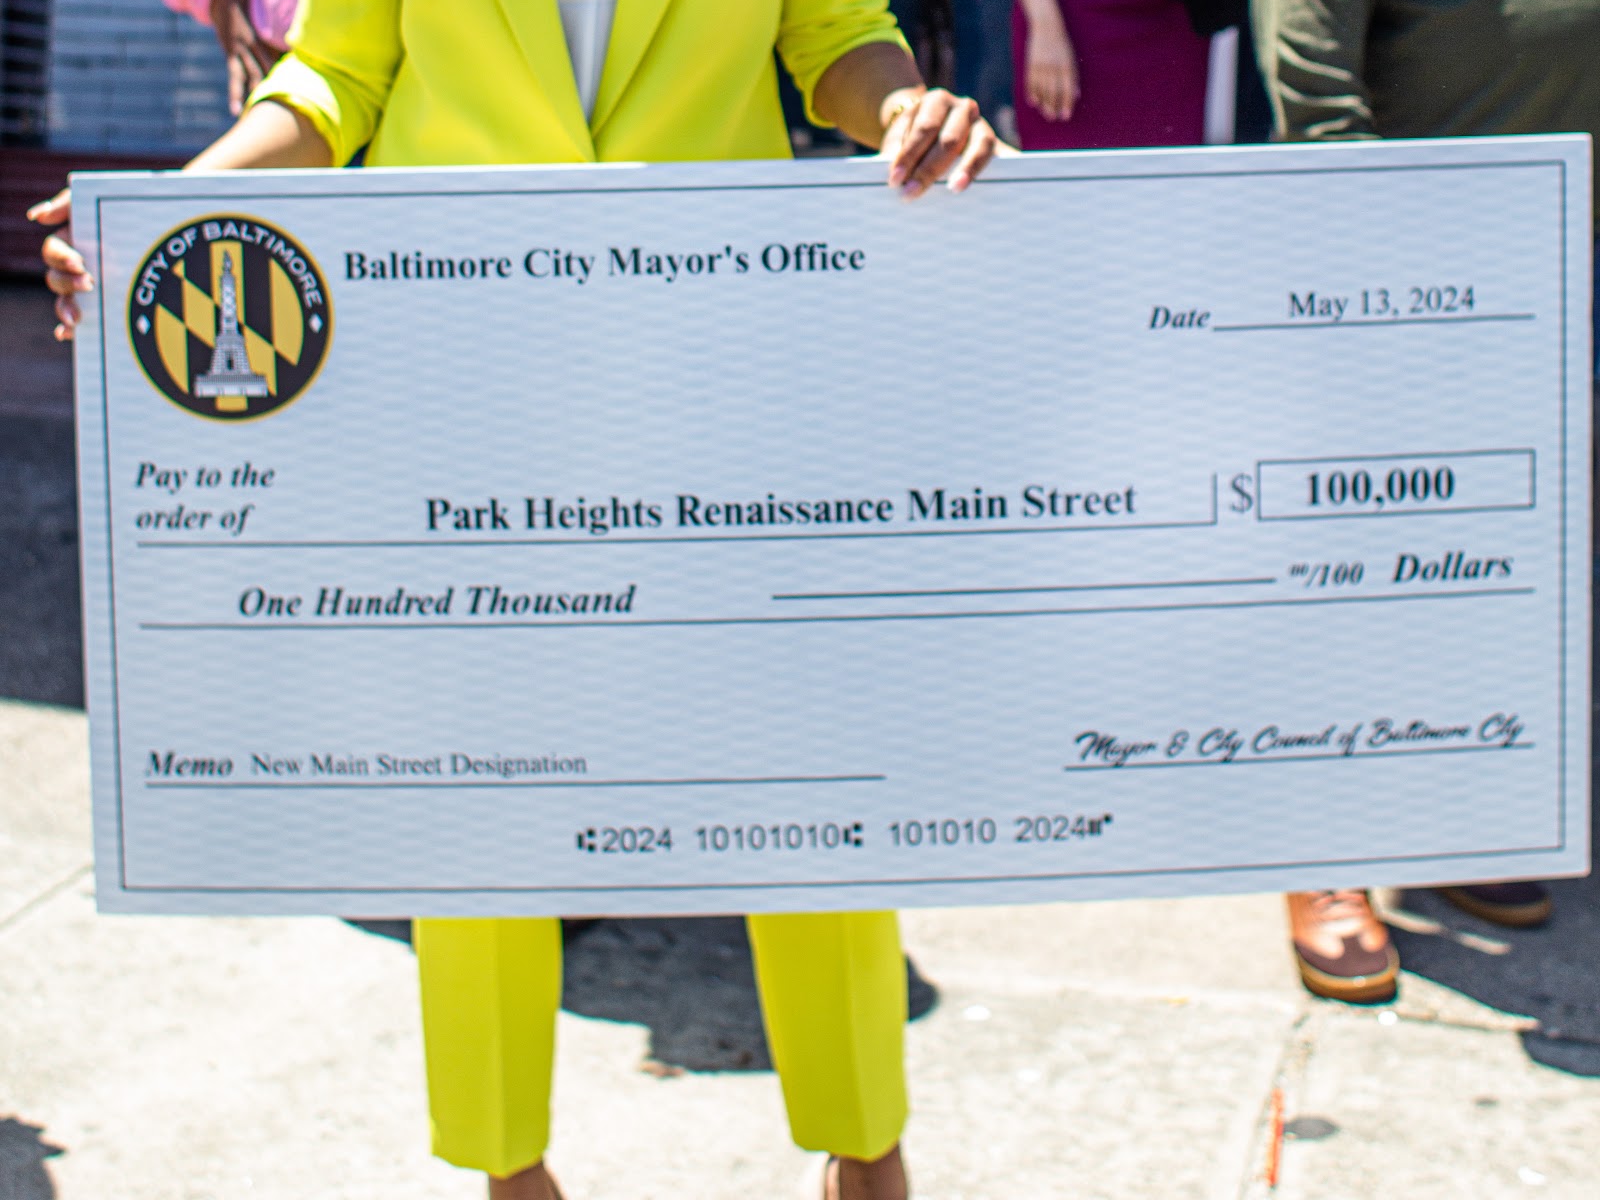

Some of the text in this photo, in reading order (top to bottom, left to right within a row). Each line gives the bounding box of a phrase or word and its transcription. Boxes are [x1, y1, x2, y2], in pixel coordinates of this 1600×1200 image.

[135, 220, 324, 309] CITY OF BALTIMORE
[344, 242, 866, 284] Baltimore City Mayor's Office
[1149, 286, 1475, 330] Date May 13, 2024
[135, 462, 275, 494] Pay to the
[1229, 466, 1455, 513] $ 100,000
[135, 504, 255, 536] order of
[426, 485, 1135, 535] Park Heights Renaissance Main Street
[238, 588, 302, 617] One
[315, 587, 454, 617] Hundred
[468, 584, 636, 616] Thousand
[1393, 552, 1511, 584] Dollars
[1074, 730, 1157, 767] Mayor
[1336, 722, 1364, 757] of
[1367, 717, 1472, 748] Baltimore
[147, 751, 588, 779] Memo New Main Street Designation
[889, 818, 997, 846] 101010
